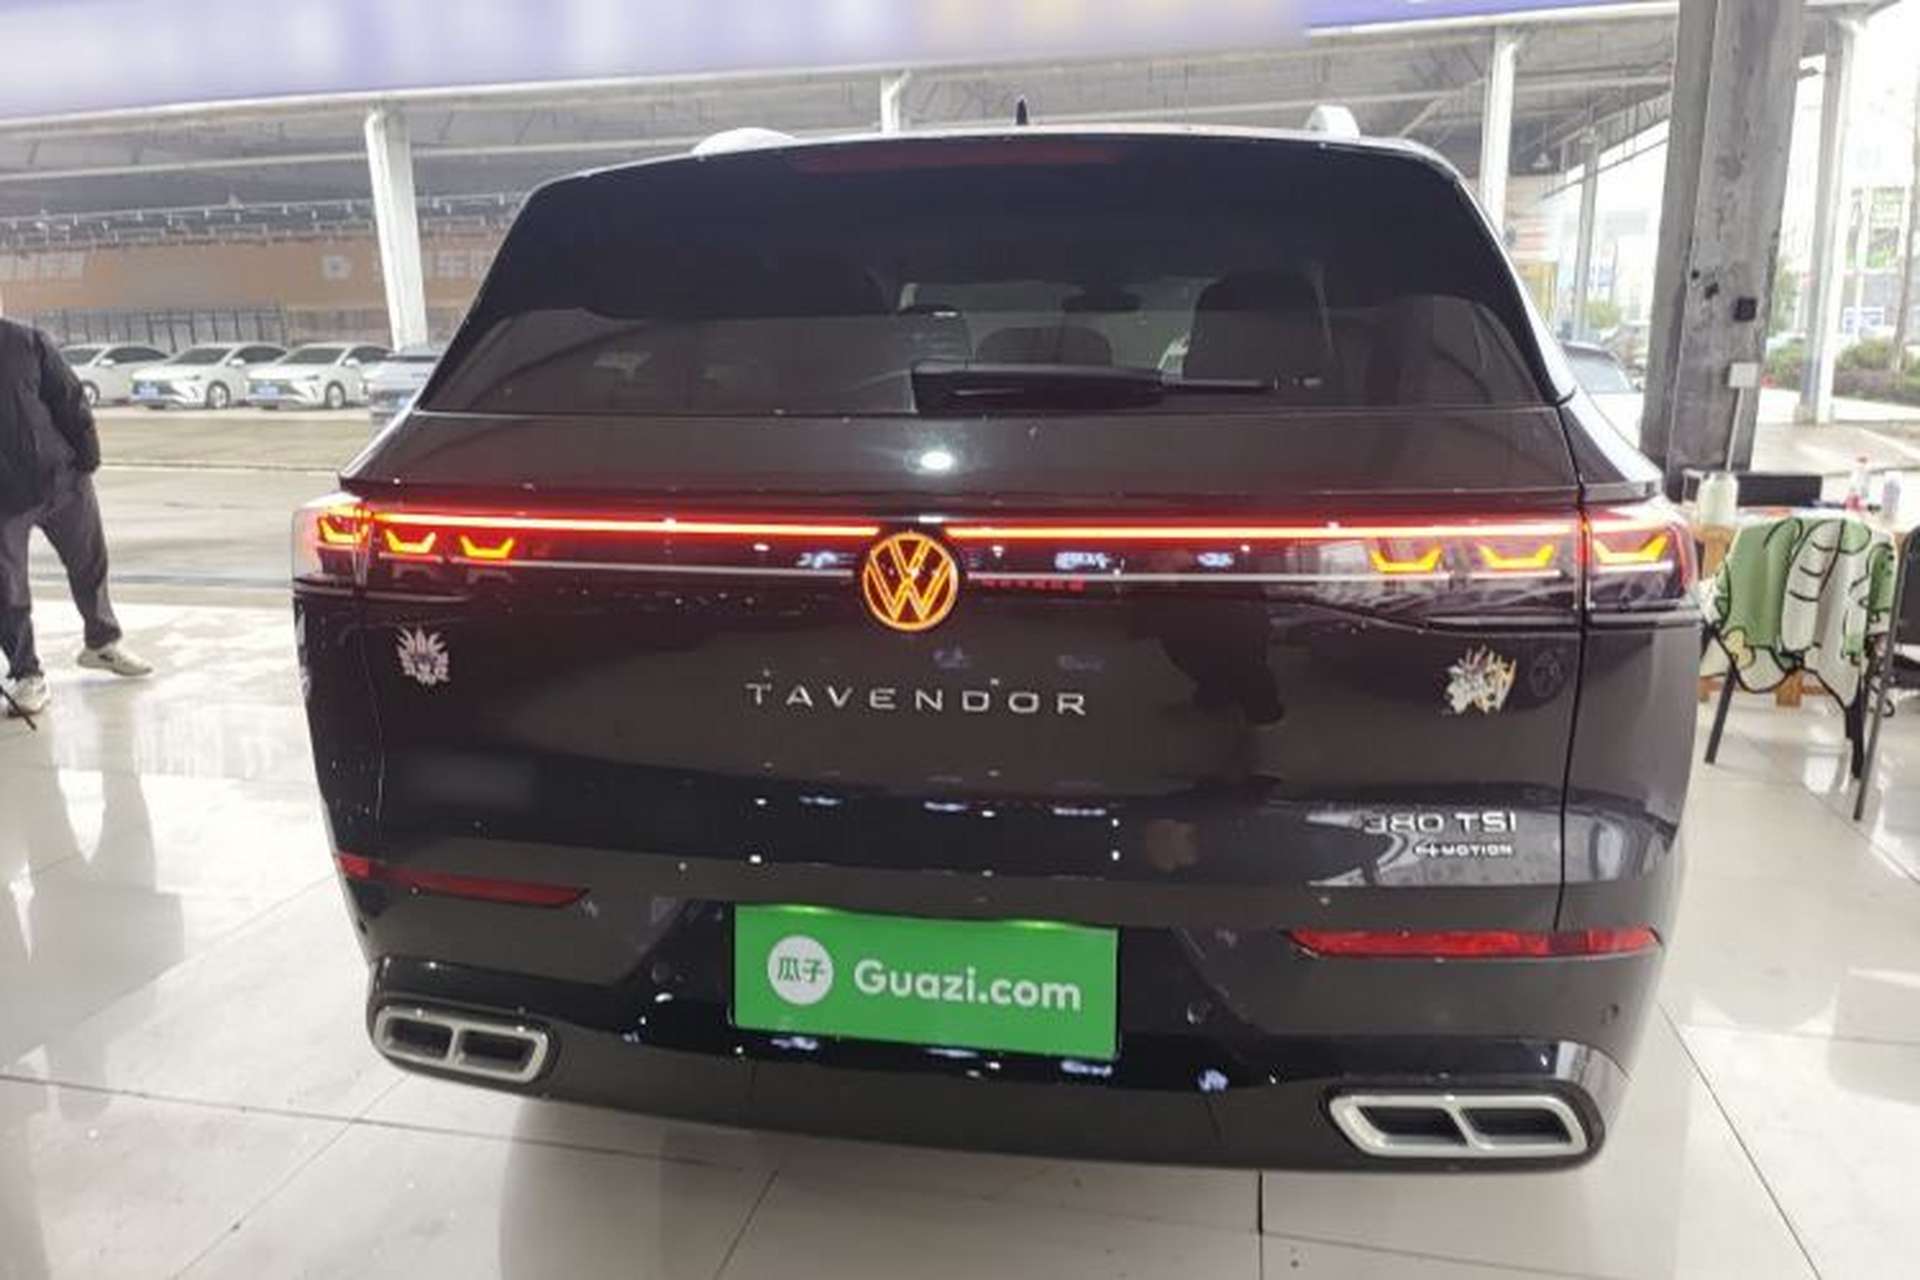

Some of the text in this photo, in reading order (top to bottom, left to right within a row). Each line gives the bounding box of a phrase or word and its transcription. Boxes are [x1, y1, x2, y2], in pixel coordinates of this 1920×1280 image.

[745, 683, 1087, 716] TAVENDOR
[1363, 810, 1517, 834] 380 TSI
[777, 957, 824, 984] 瓜子
[854, 958, 1083, 1011] Guazi.com
